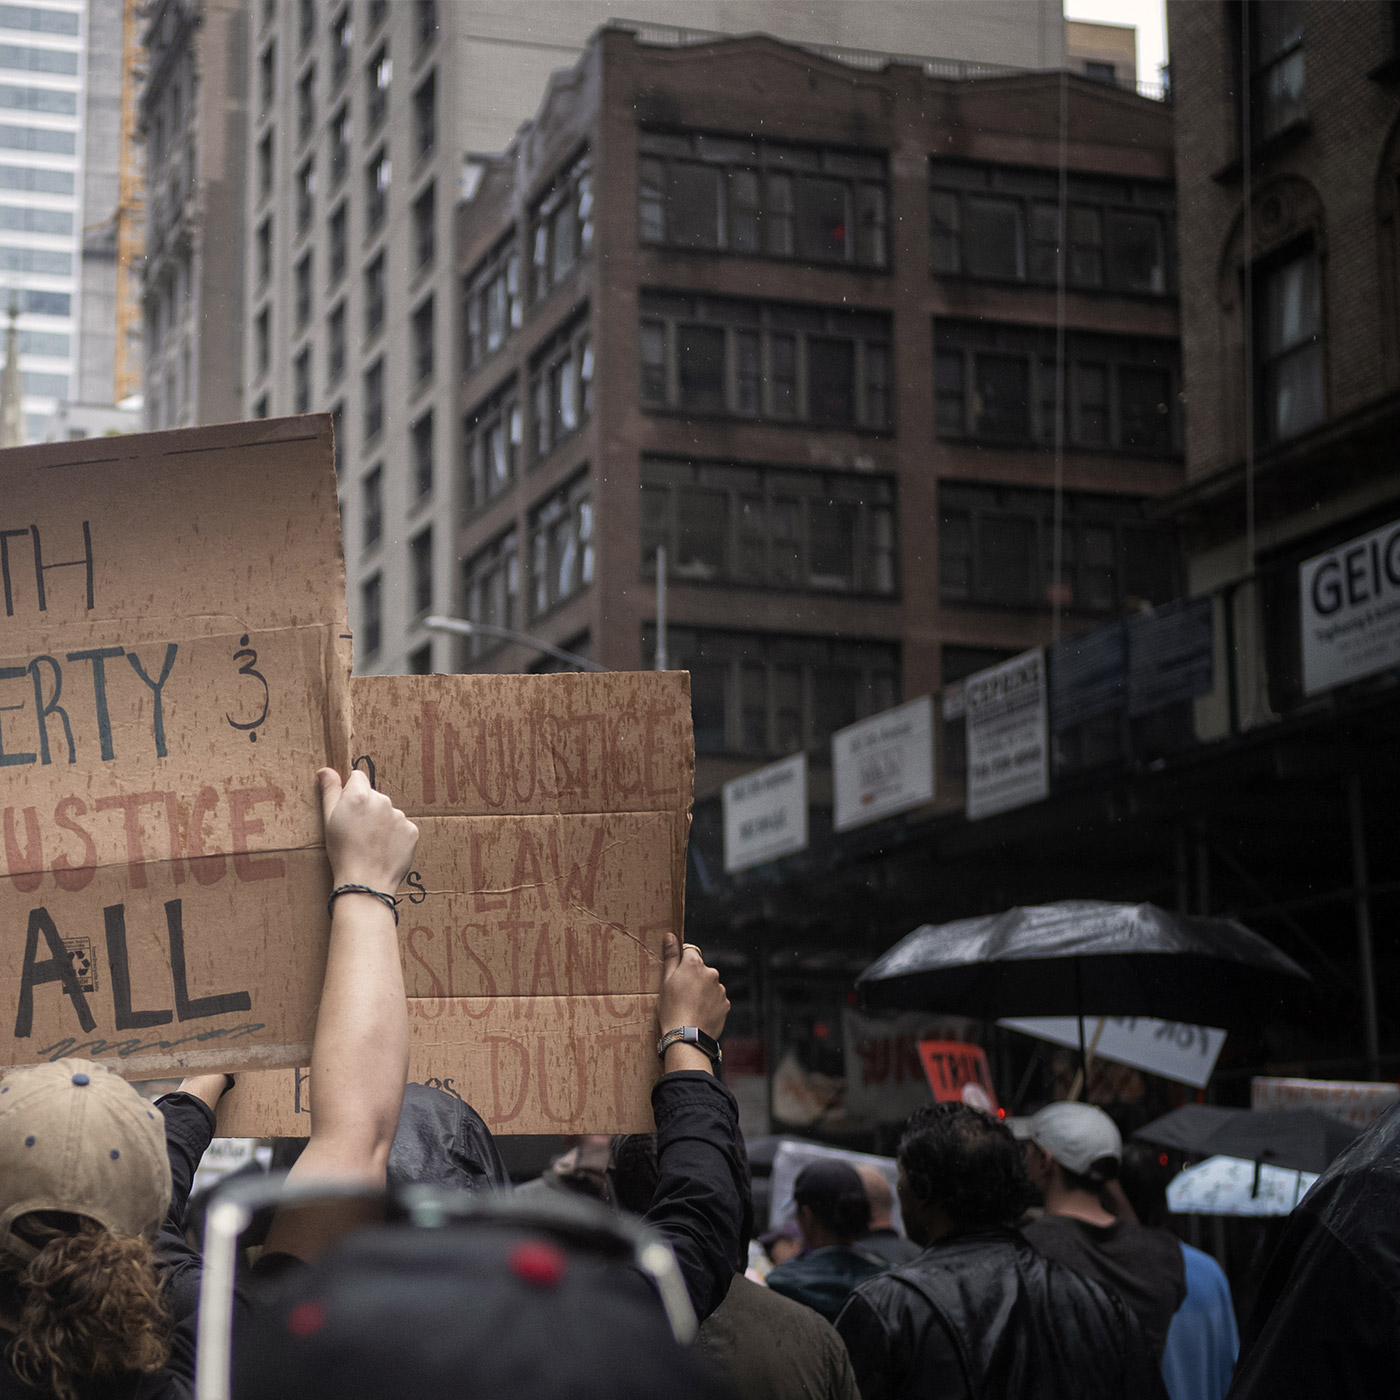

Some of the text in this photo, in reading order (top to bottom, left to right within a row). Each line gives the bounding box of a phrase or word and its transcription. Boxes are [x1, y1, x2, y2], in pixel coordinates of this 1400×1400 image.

[420, 700, 678, 808] INJUSTICE
[469, 826, 606, 914] LAW
[14, 897, 252, 1039] ALL
